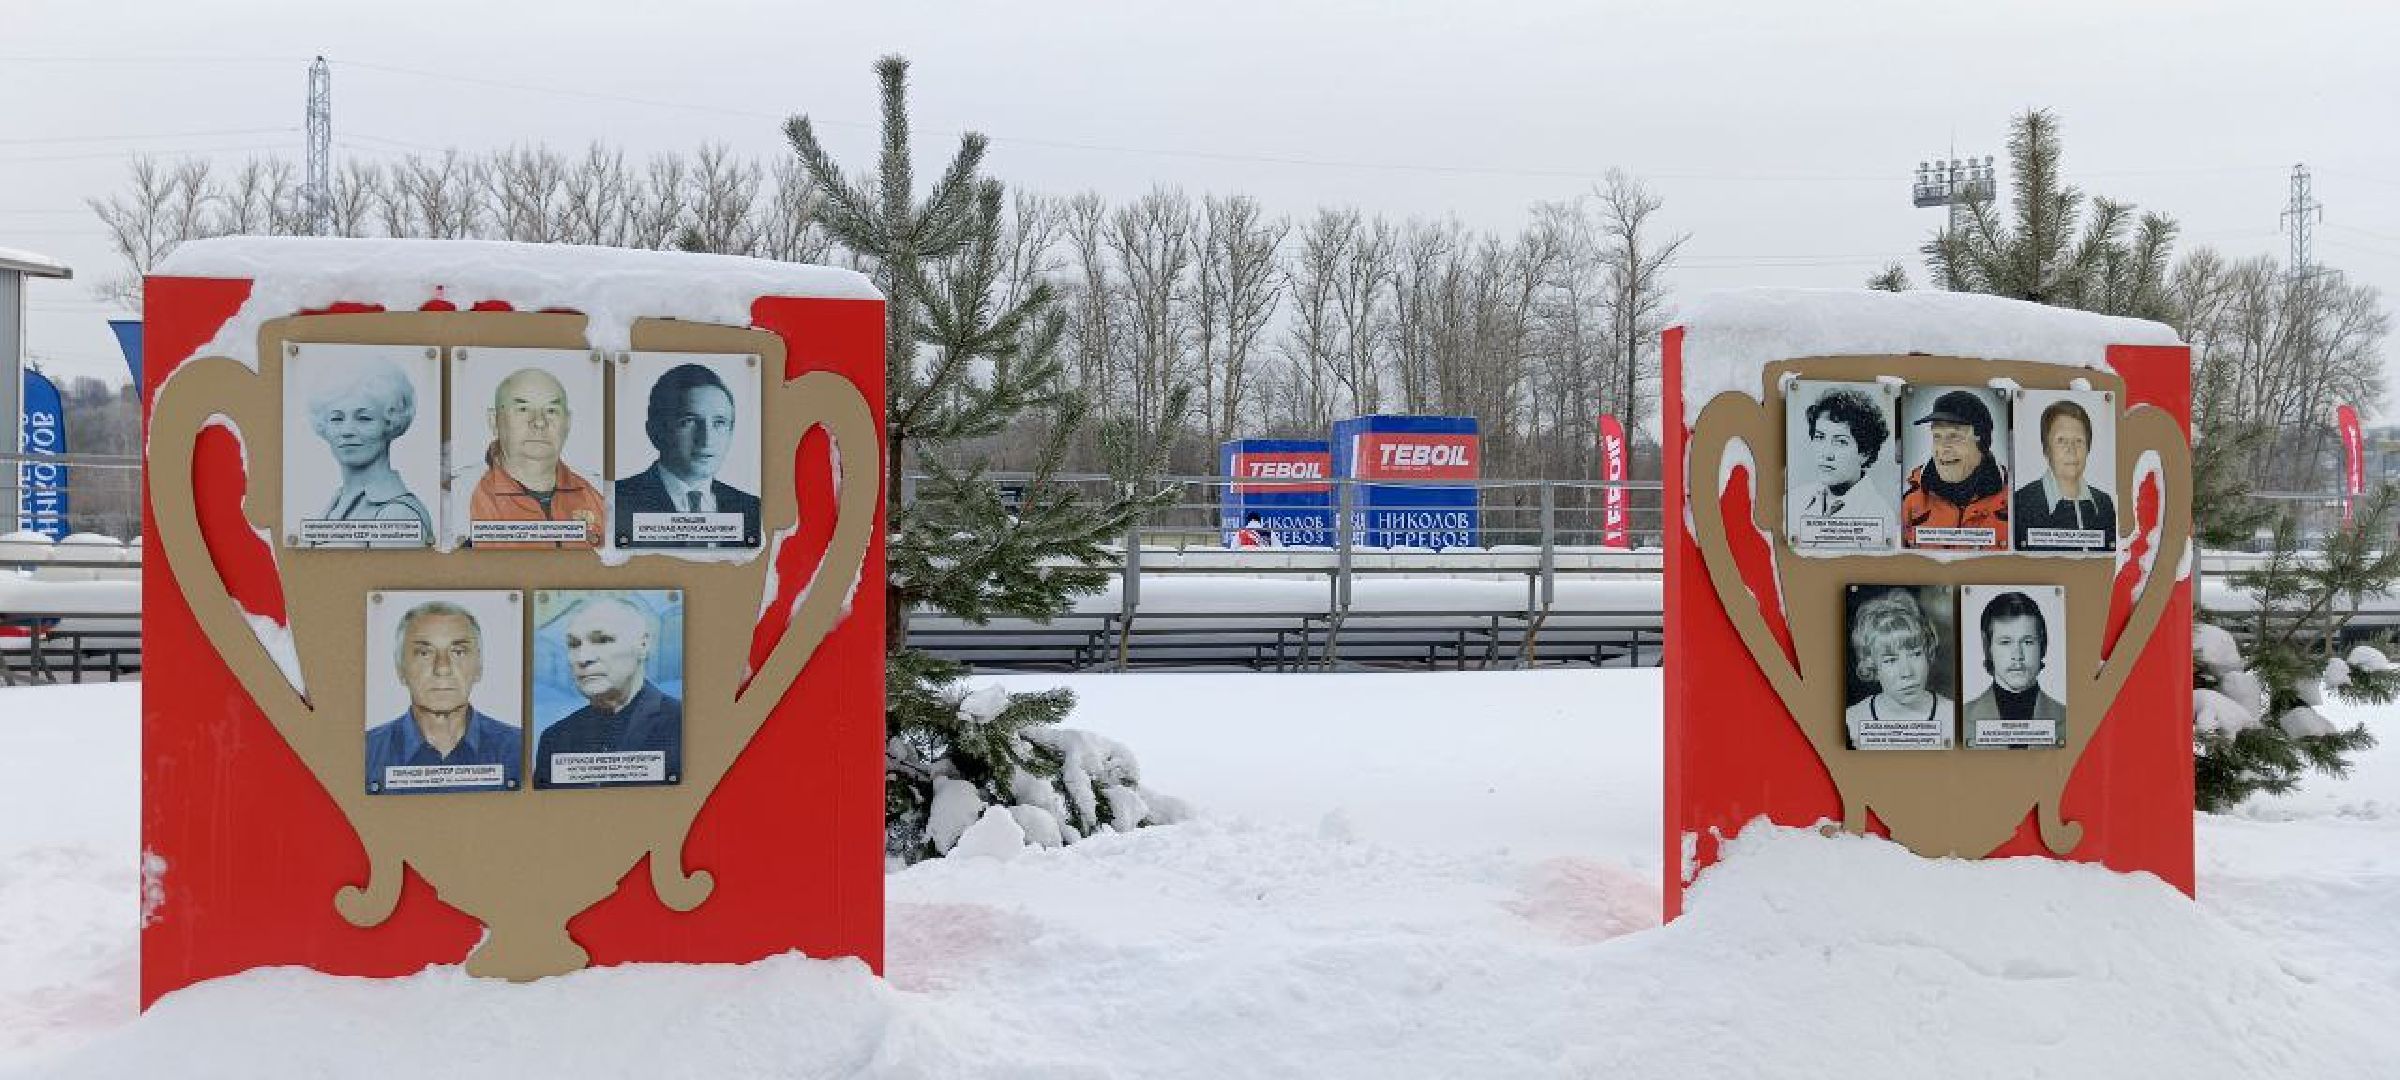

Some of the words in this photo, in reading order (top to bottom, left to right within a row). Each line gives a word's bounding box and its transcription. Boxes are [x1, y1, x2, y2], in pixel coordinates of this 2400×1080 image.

[1380, 443, 1469, 466] TEBOIL
[1249, 462, 1322, 479] TEBOIL
[1257, 516, 1324, 529] ИКОЛОВ
[1379, 512, 1469, 529] НИКОЛОВ
[1379, 531, 1469, 547] ПЕРЕВОЗ
